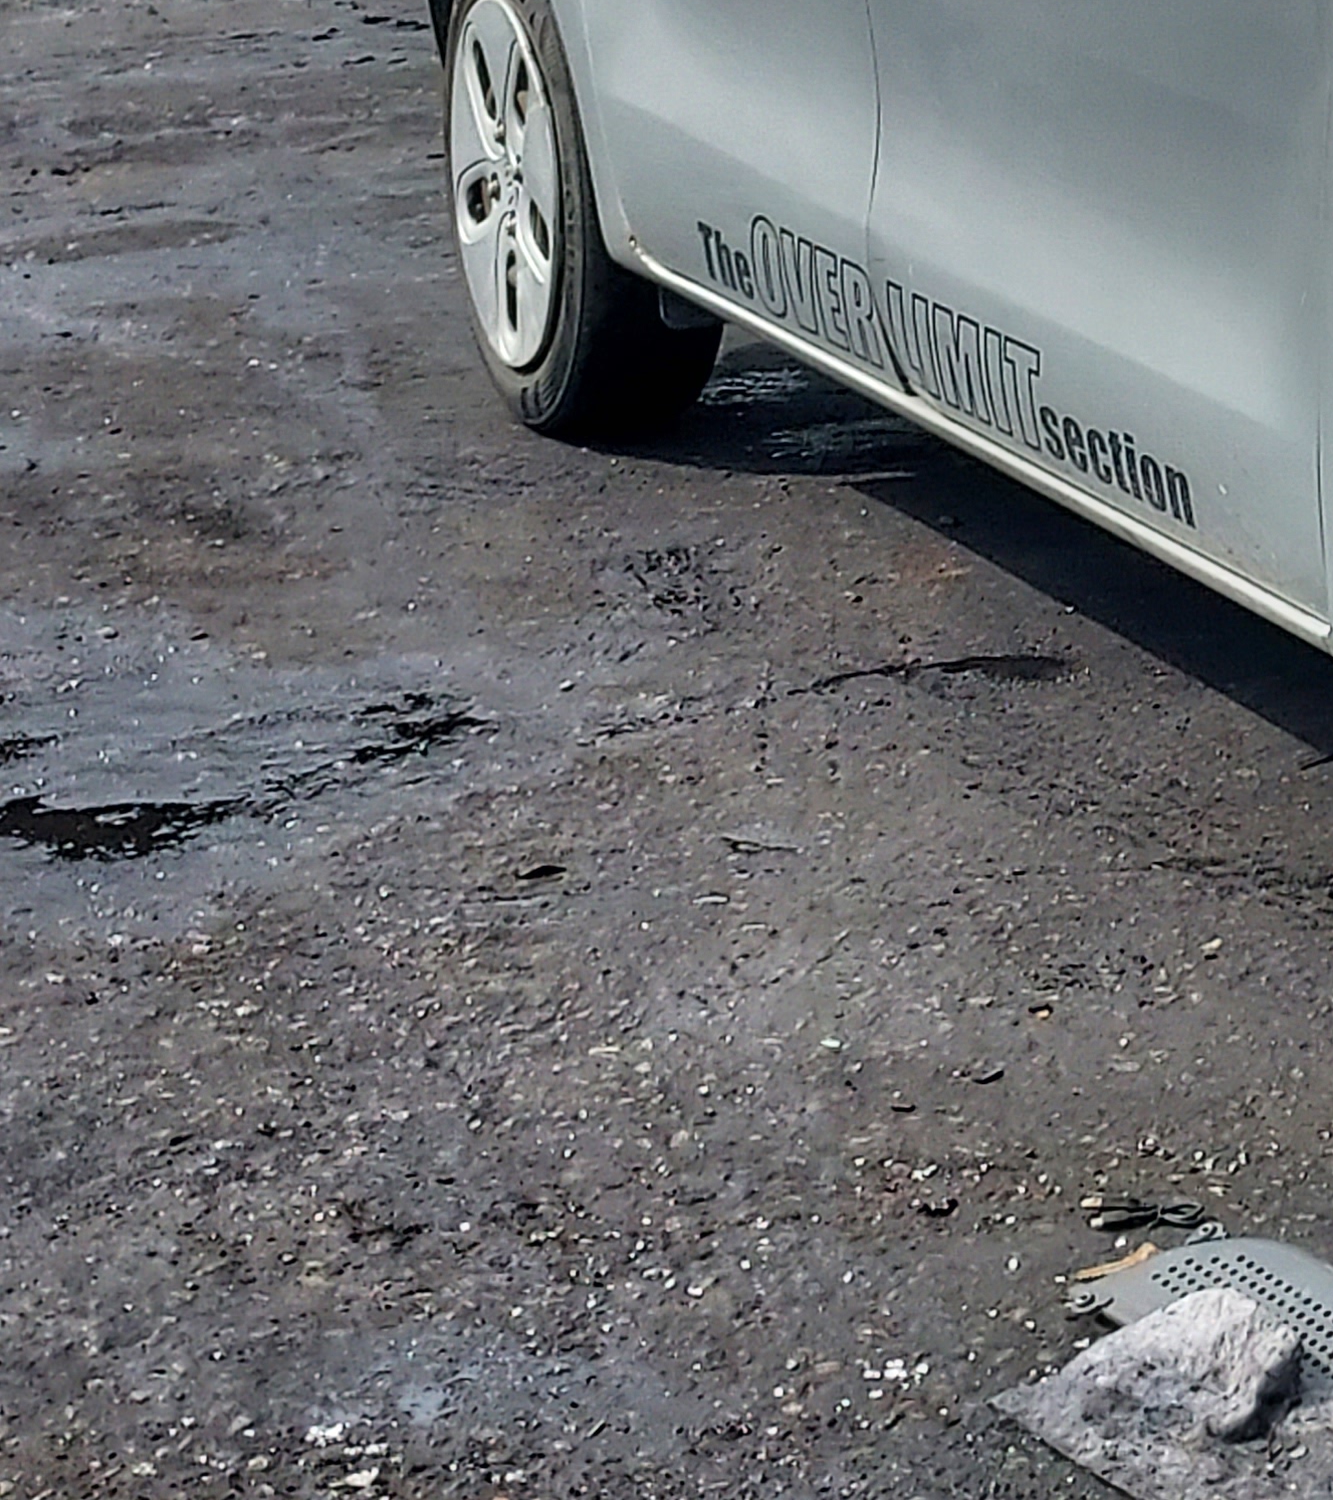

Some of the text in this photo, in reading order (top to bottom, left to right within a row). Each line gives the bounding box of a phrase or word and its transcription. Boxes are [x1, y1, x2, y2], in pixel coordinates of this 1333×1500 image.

[697, 221, 753, 299] The
[750, 214, 883, 370] OVER
[1041, 403, 1197, 529] section
